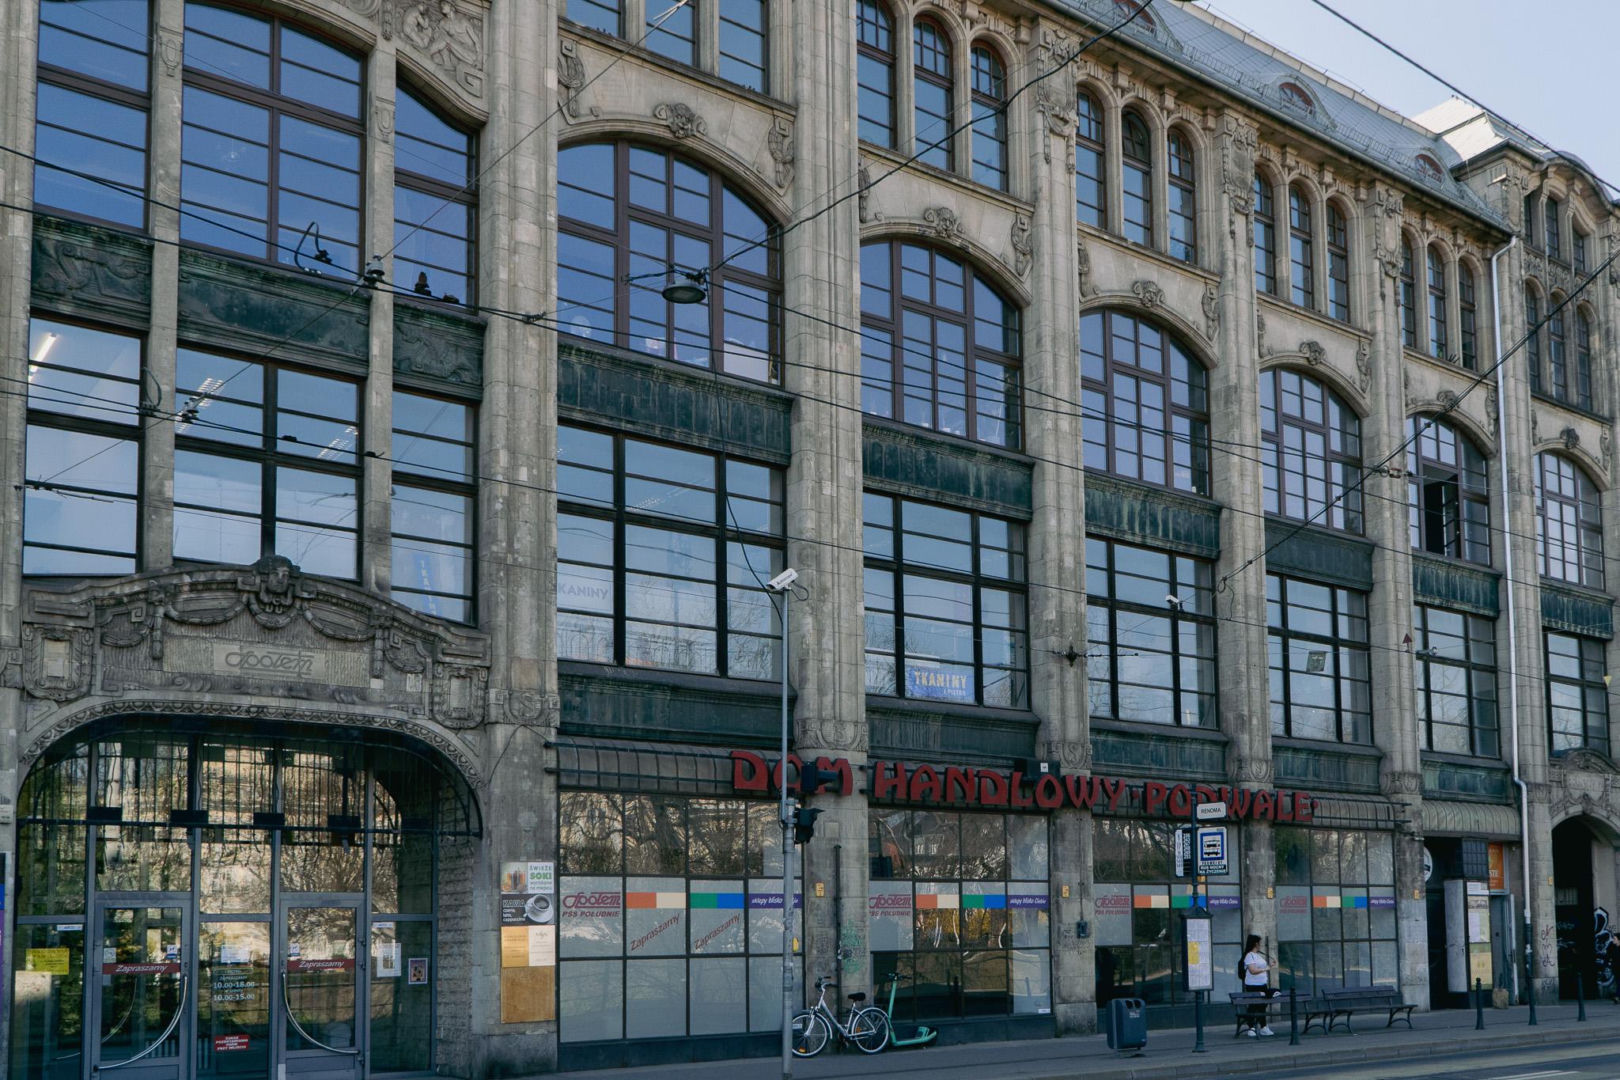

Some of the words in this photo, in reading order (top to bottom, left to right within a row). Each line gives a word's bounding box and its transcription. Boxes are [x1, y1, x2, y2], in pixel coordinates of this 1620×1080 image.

[914, 671, 967, 689] TKANINY
[731, 751, 853, 796] DOM
[875, 761, 1126, 811] HANDLOWY
[1200, 807, 1222, 815] RENOMA
[529, 872, 553, 880] SOKI
[630, 914, 680, 951] Zapraszamy
[694, 913, 740, 950] Zapraszamy
[114, 964, 168, 974] Zapraszamy
[298, 959, 345, 969] Zapraszamy
